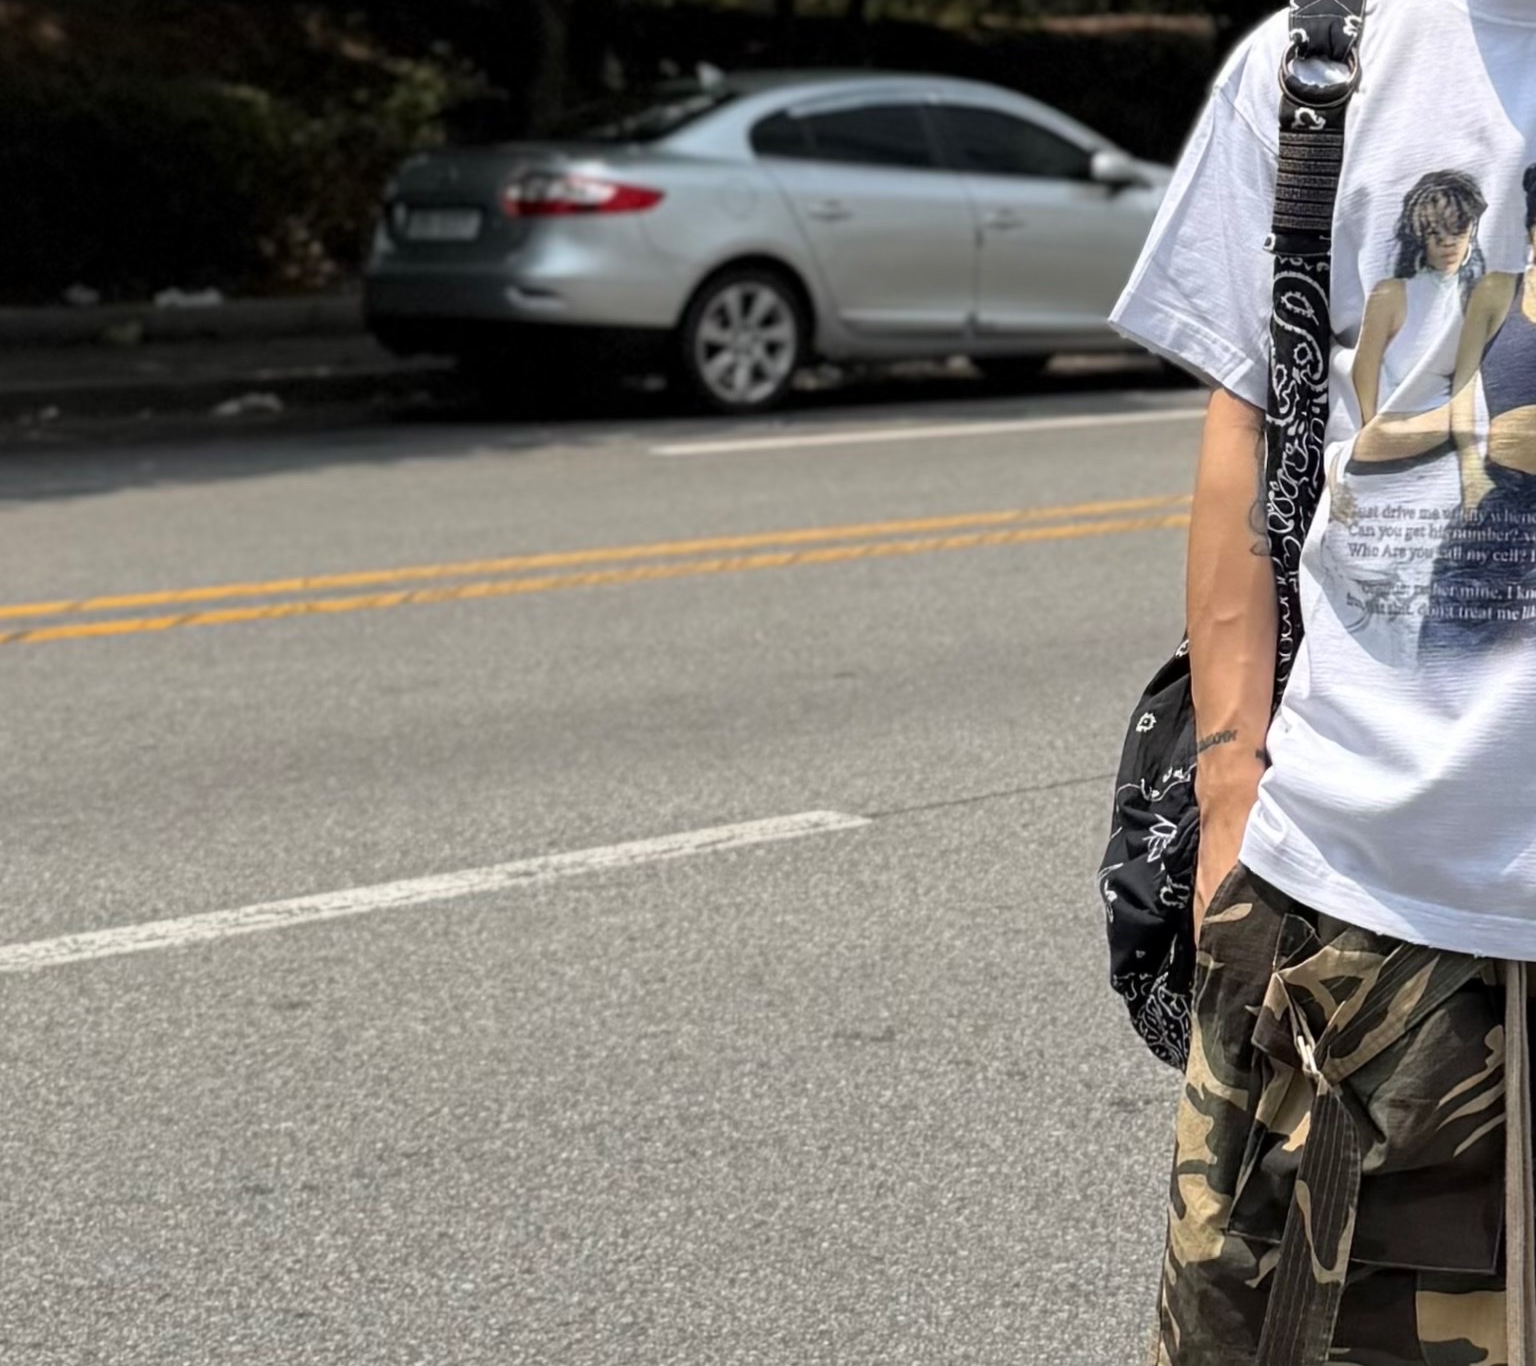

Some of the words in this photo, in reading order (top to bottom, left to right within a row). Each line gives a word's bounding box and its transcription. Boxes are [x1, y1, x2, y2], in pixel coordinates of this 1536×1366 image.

[1382, 505, 1416, 520] drive
[1349, 521, 1375, 537] Can
[1377, 525, 1403, 542] you
[1405, 526, 1426, 542] get
[1466, 550, 1487, 566] my
[1458, 605, 1493, 620] treat
[1496, 608, 1521, 621] me
